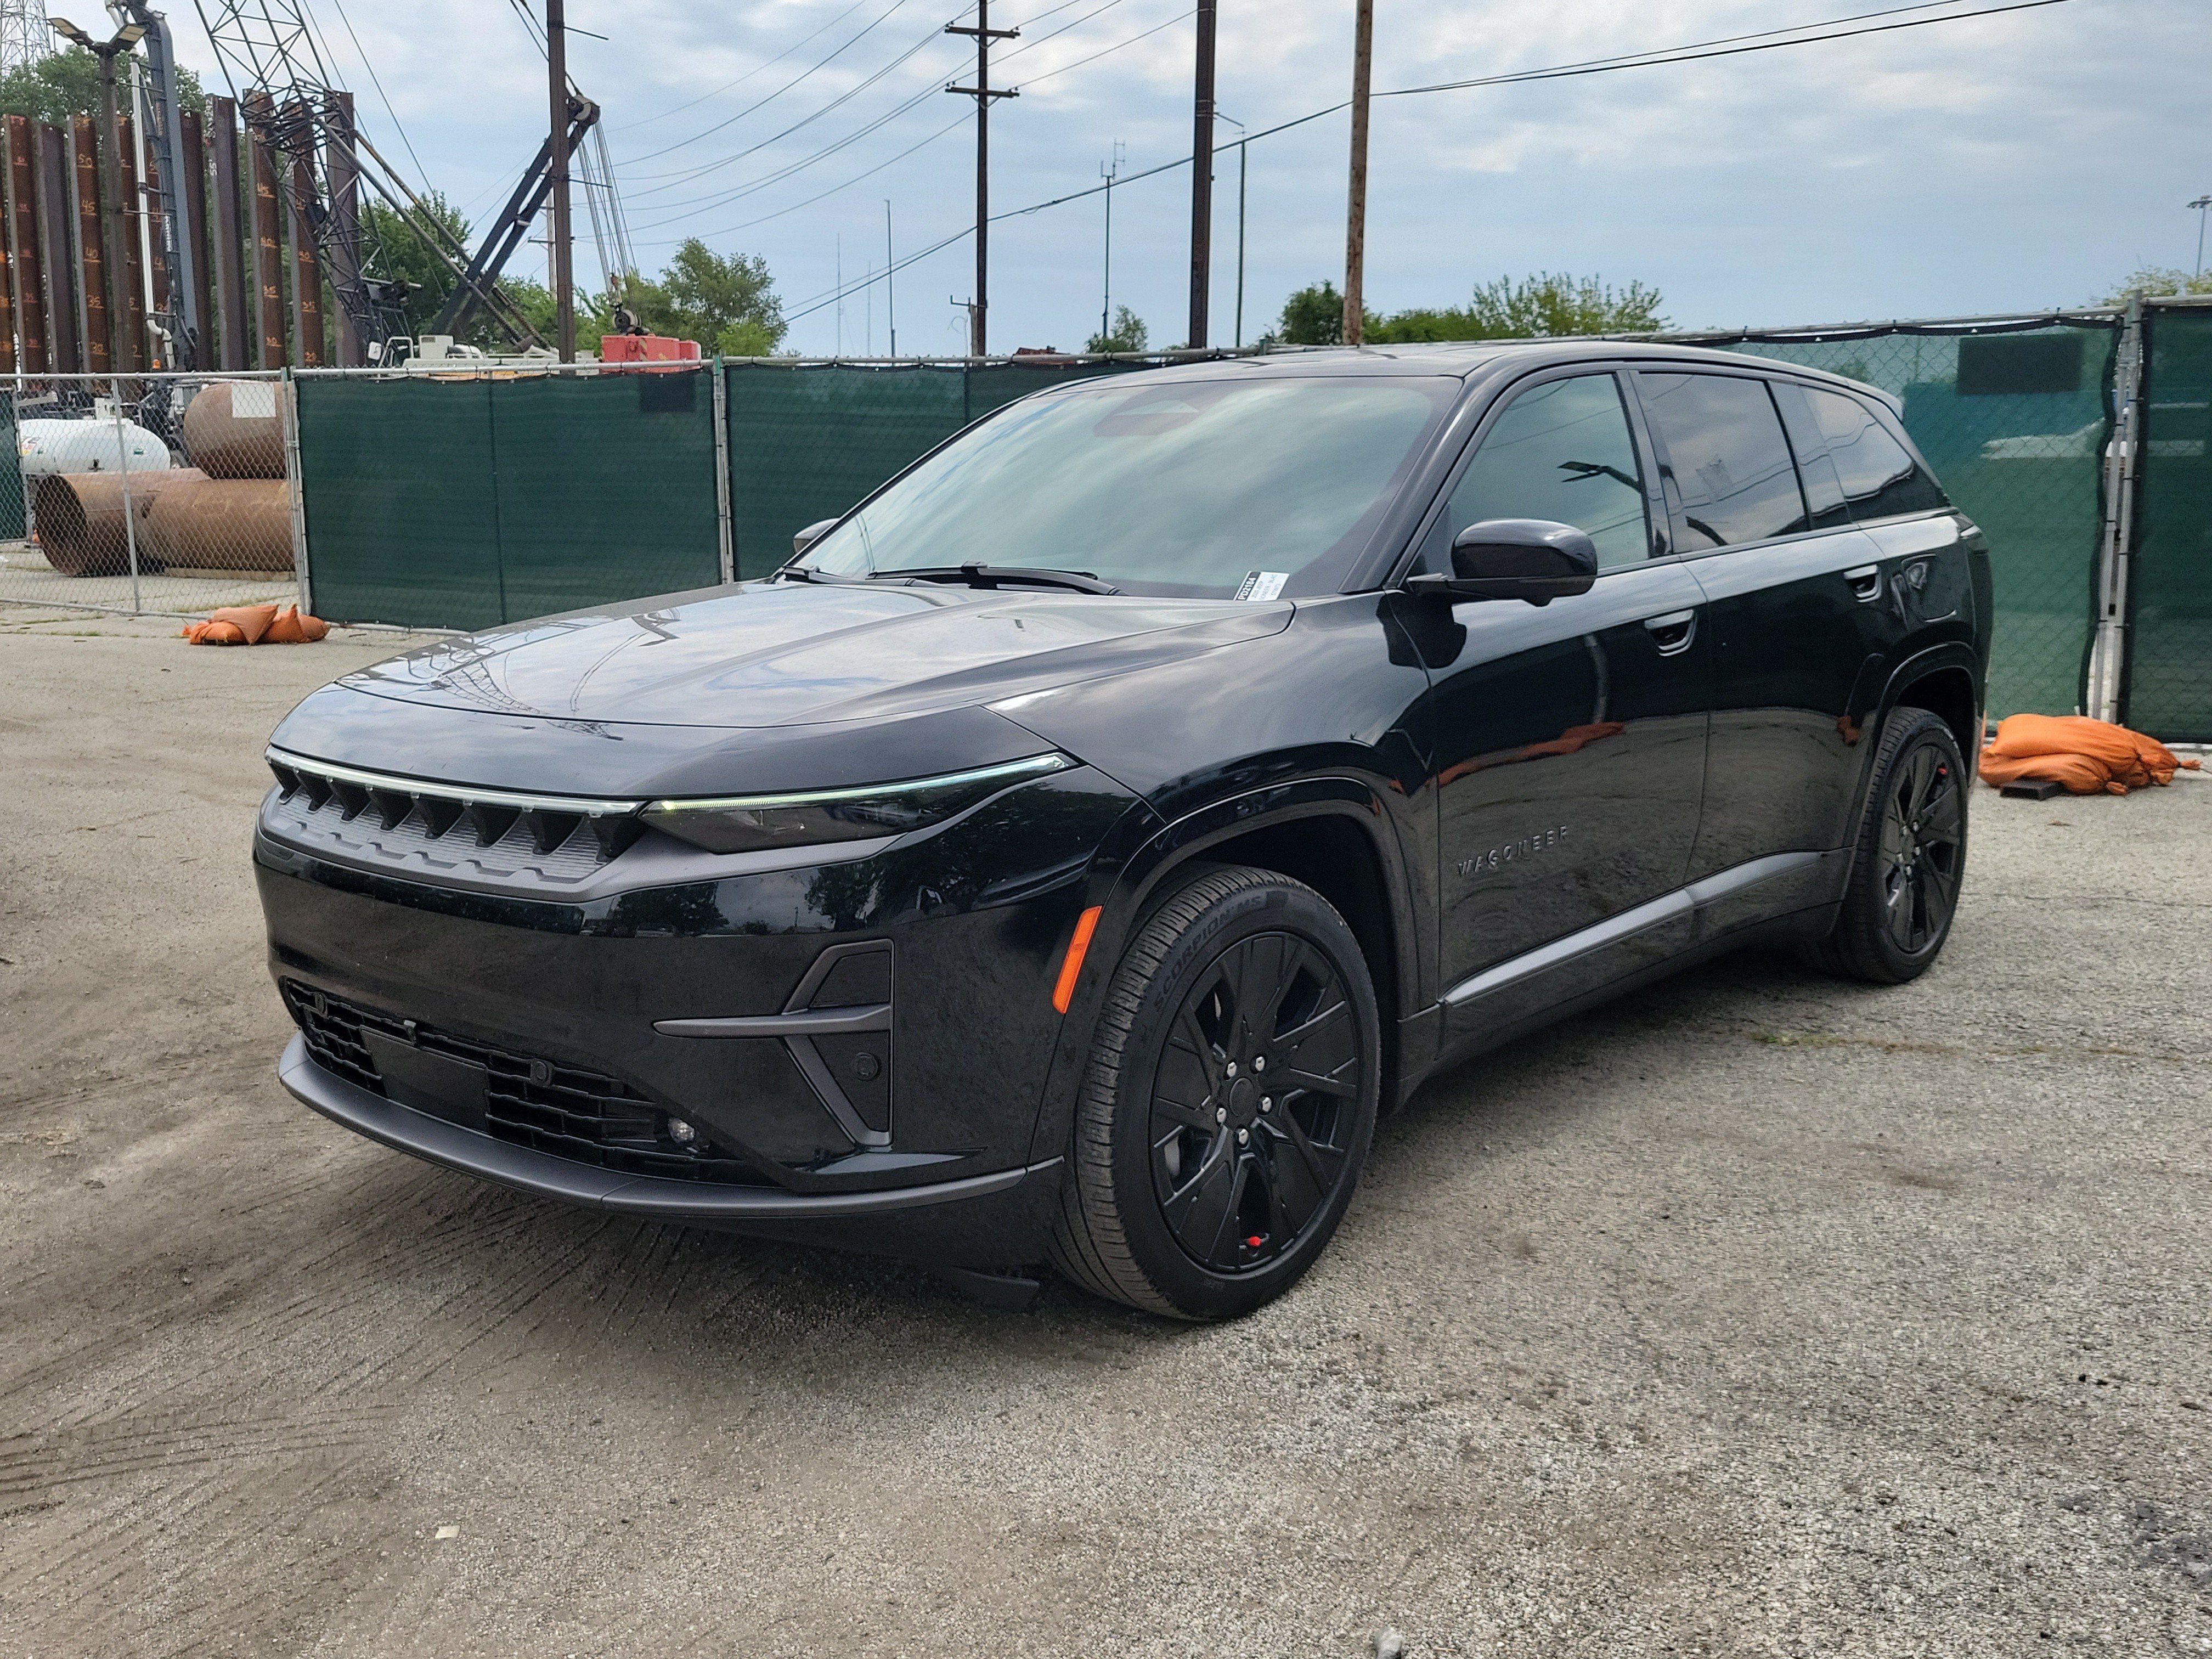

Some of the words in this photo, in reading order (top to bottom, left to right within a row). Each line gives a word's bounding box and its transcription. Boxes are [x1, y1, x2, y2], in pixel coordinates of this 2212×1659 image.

[78, 154, 93, 166] 50
[82, 200, 95, 212] 45
[85, 246, 98, 258] 40
[1237, 577, 1257, 600] PD2184
[1458, 825, 1568, 877] WAGONEER
[1153, 909, 1231, 1012] SCORPION
